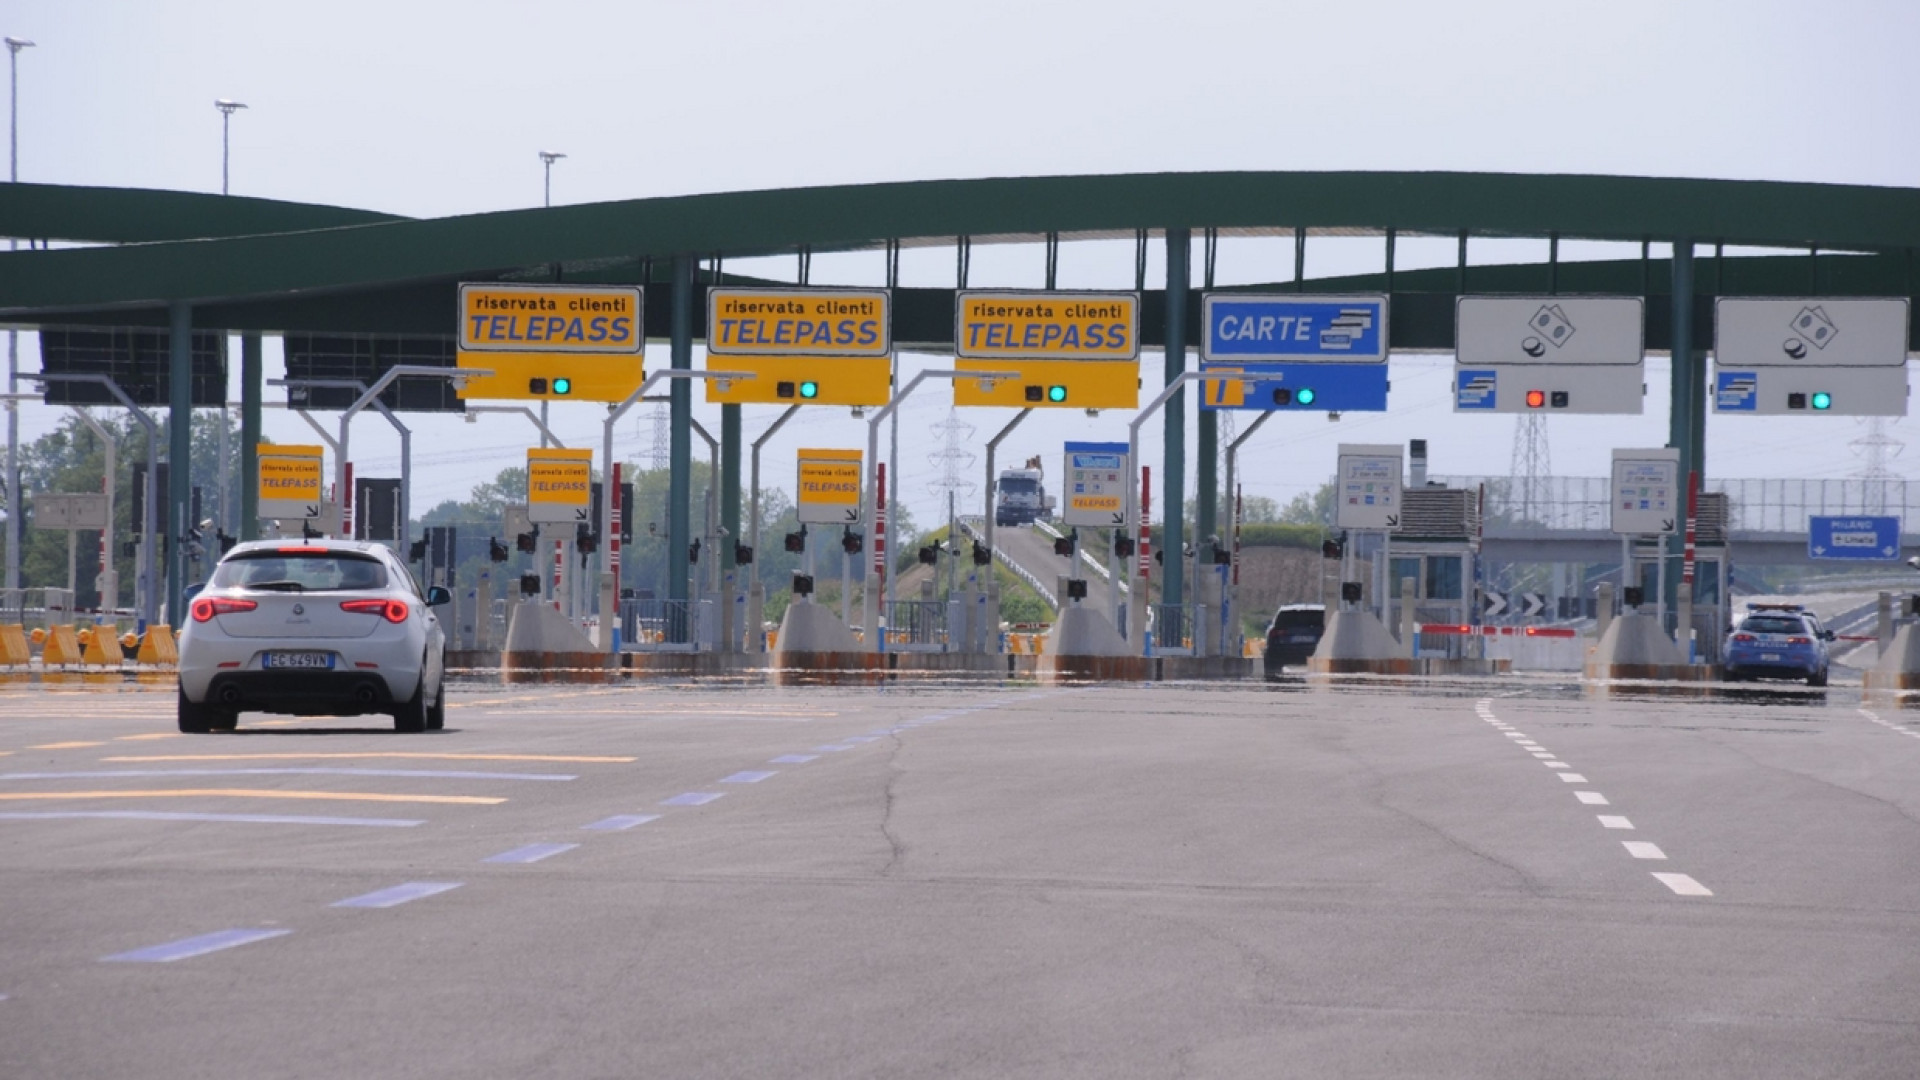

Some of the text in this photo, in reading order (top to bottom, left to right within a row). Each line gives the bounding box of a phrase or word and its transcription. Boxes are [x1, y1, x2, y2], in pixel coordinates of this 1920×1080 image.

[476, 297, 626, 312] riservata clienti
[725, 300, 874, 315] riservata clienti
[973, 303, 1122, 318] riservata clienti
[470, 315, 631, 341] TELEPASS
[719, 319, 878, 344] TELEPASS
[1219, 315, 1312, 341] CARTE
[968, 323, 1127, 349] TELEPASS
[263, 478, 317, 488] TELEPASS
[533, 481, 587, 491] TELEPASS
[803, 482, 857, 492] TELEPASS
[1074, 498, 1117, 508] TELEPASS
